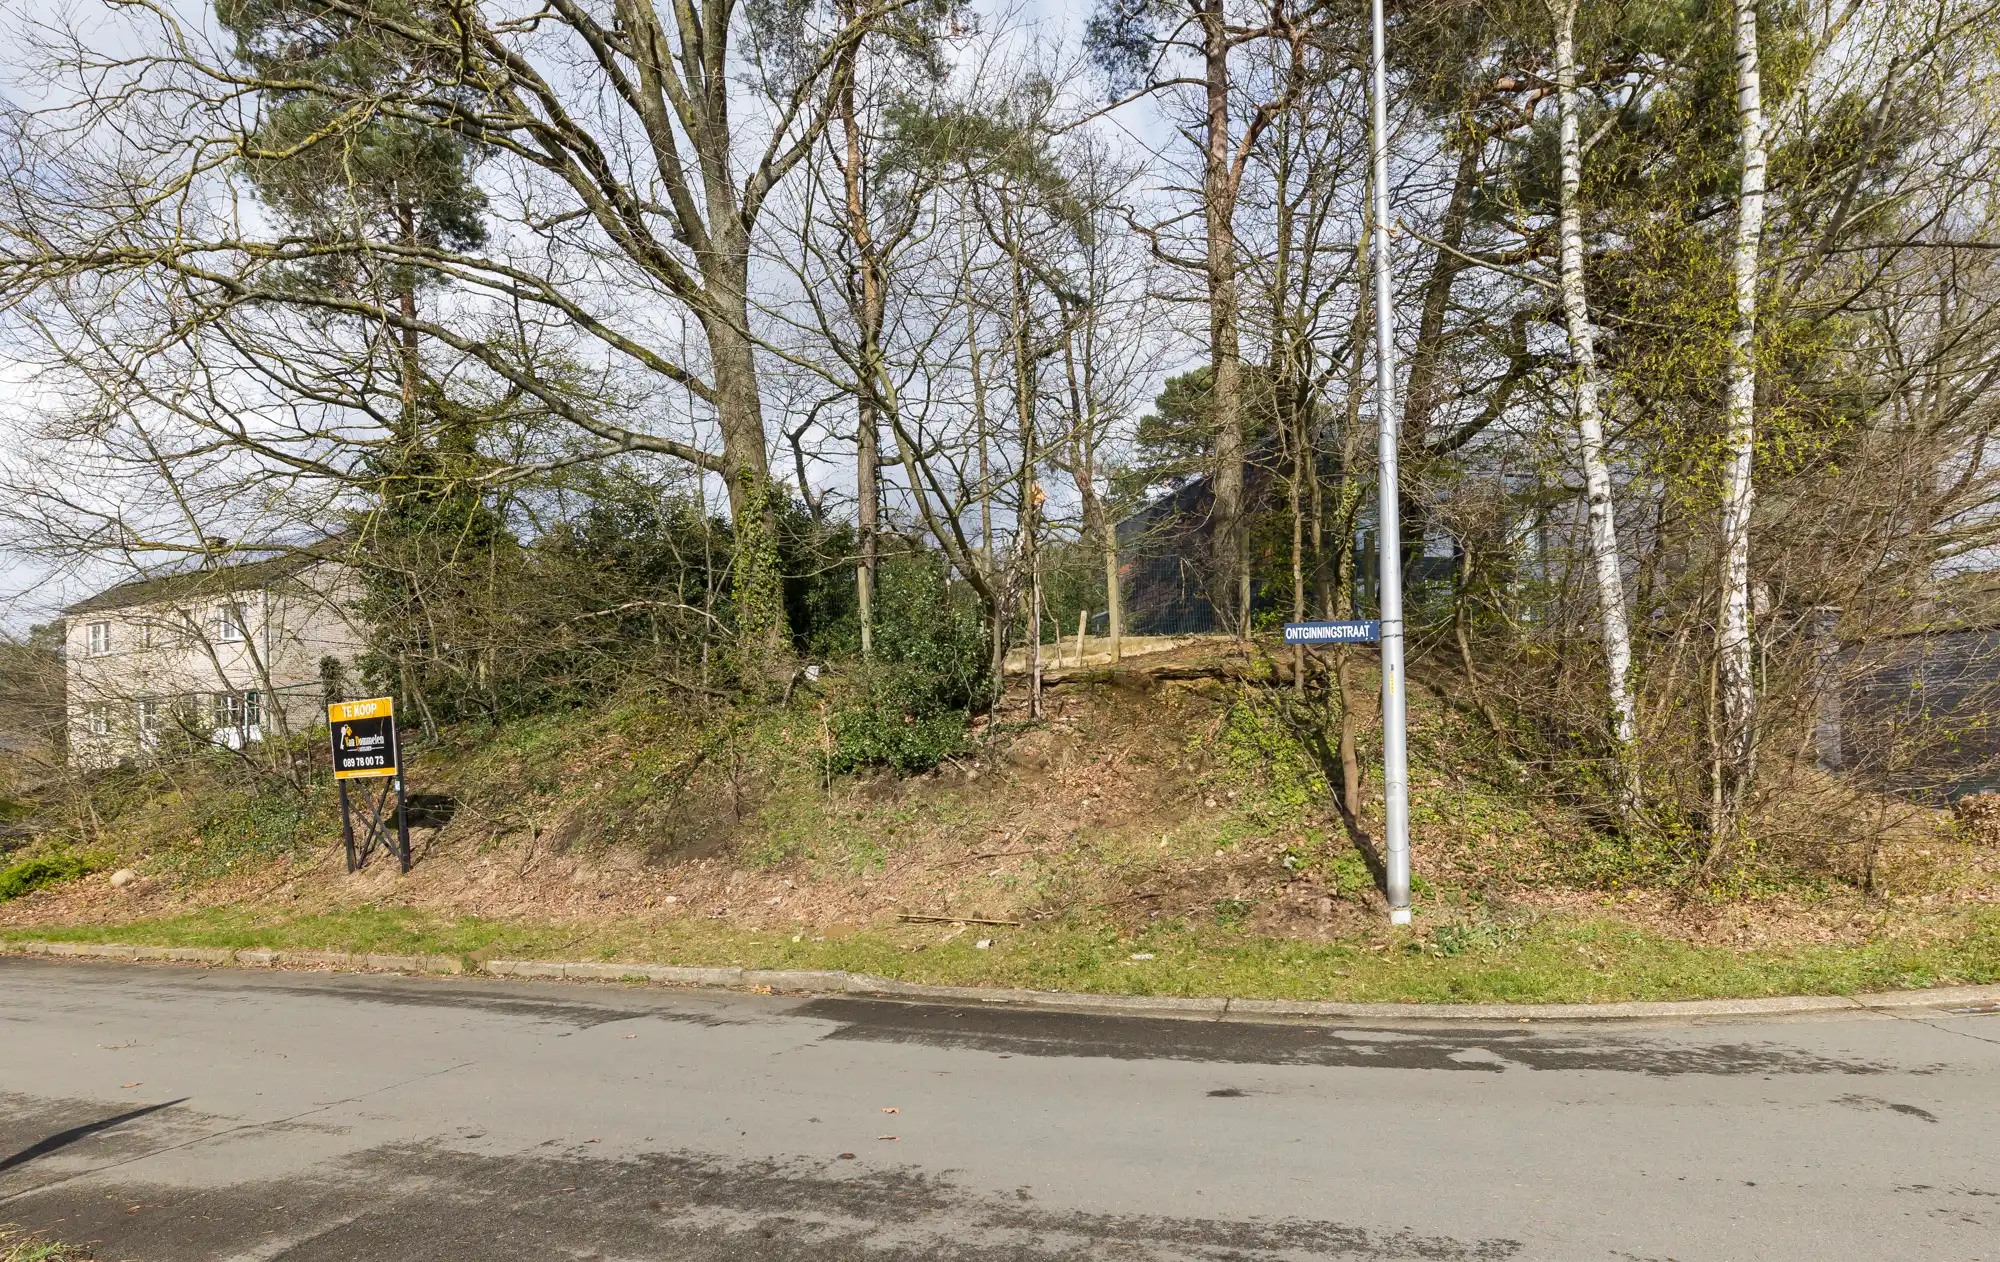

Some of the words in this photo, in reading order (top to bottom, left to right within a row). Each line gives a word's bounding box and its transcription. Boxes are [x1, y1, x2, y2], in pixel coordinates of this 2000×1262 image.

[1285, 624, 1370, 639] ONTGINNINGSTRAAT
[342, 706, 352, 718] TE
[354, 703, 377, 716] KOOP
[345, 736, 355, 747] Van
[355, 734, 385, 747] Dommelen
[343, 757, 355, 767] 089
[356, 757, 364, 767] 78
[365, 756, 374, 766] 00
[375, 756, 384, 765] 73
